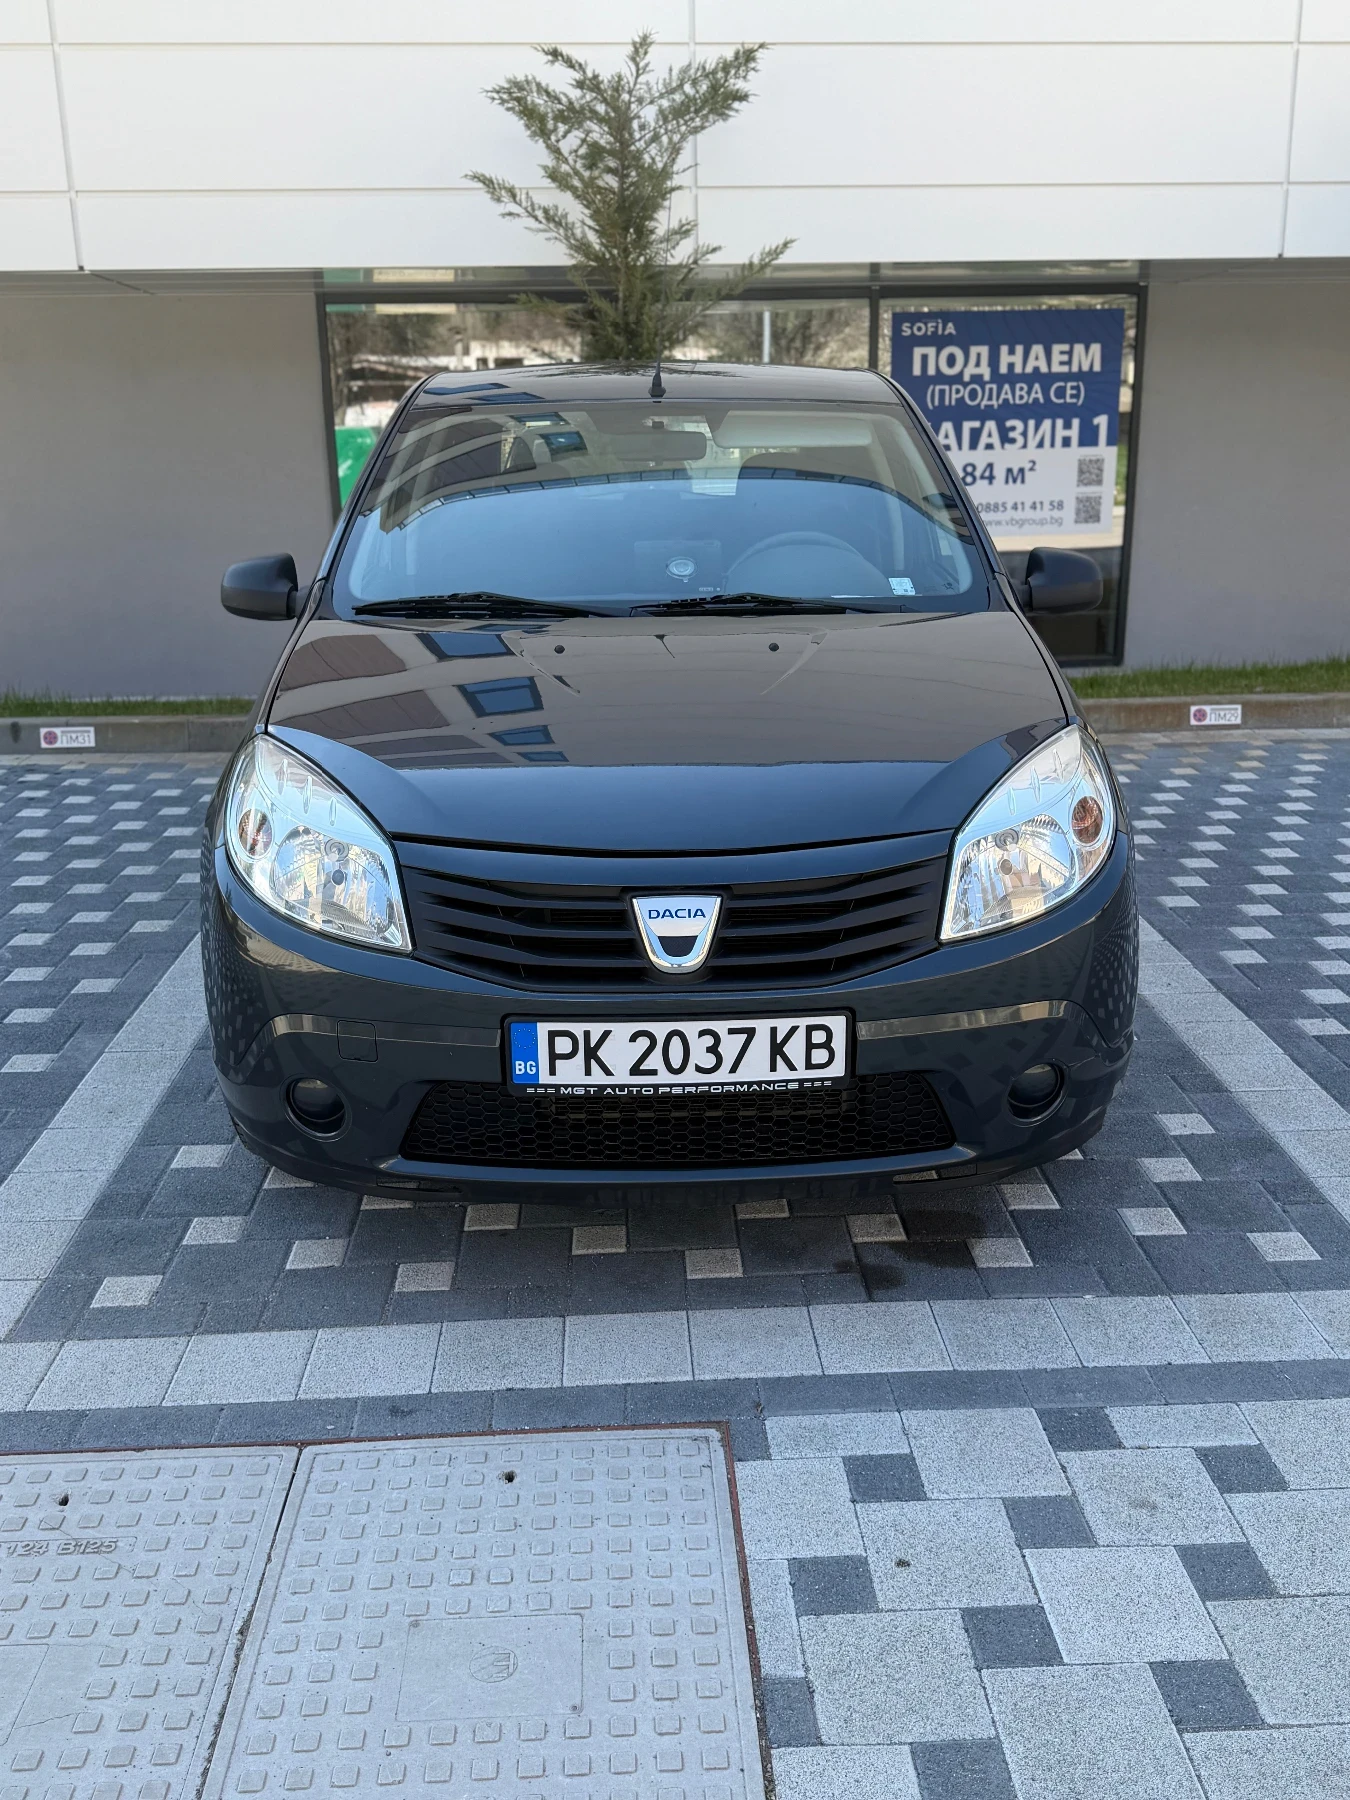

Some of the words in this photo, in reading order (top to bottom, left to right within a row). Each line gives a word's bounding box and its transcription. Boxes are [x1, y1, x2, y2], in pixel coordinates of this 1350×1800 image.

[912, 345, 991, 382] ПОД
[999, 343, 1101, 374] НАЕМ
[926, 382, 1044, 410] (ПРОДАВА
[1049, 381, 1085, 406] СЕ)
[929, 417, 1080, 451] АГАЗИН
[1092, 414, 1109, 447] 1
[961, 462, 996, 486] 84
[977, 502, 1007, 514] 0885
[1011, 501, 1025, 512] 41
[1029, 500, 1044, 511] 41
[1048, 499, 1064, 511] 58
[1209, 711, 1239, 722] ПМ29
[60, 734, 91, 745] ПМ31
[648, 908, 706, 919] DACIA
[547, 1029, 615, 1077] PK
[628, 1026, 757, 1076] 2037
[769, 1023, 836, 1073] KB
[515, 1061, 537, 1075] BG
[560, 1087, 598, 1095] MGT
[603, 1086, 654, 1095] AUTO
[658, 1082, 799, 1095] PERFORMANCE
[57, 1538, 118, 1555] B125
